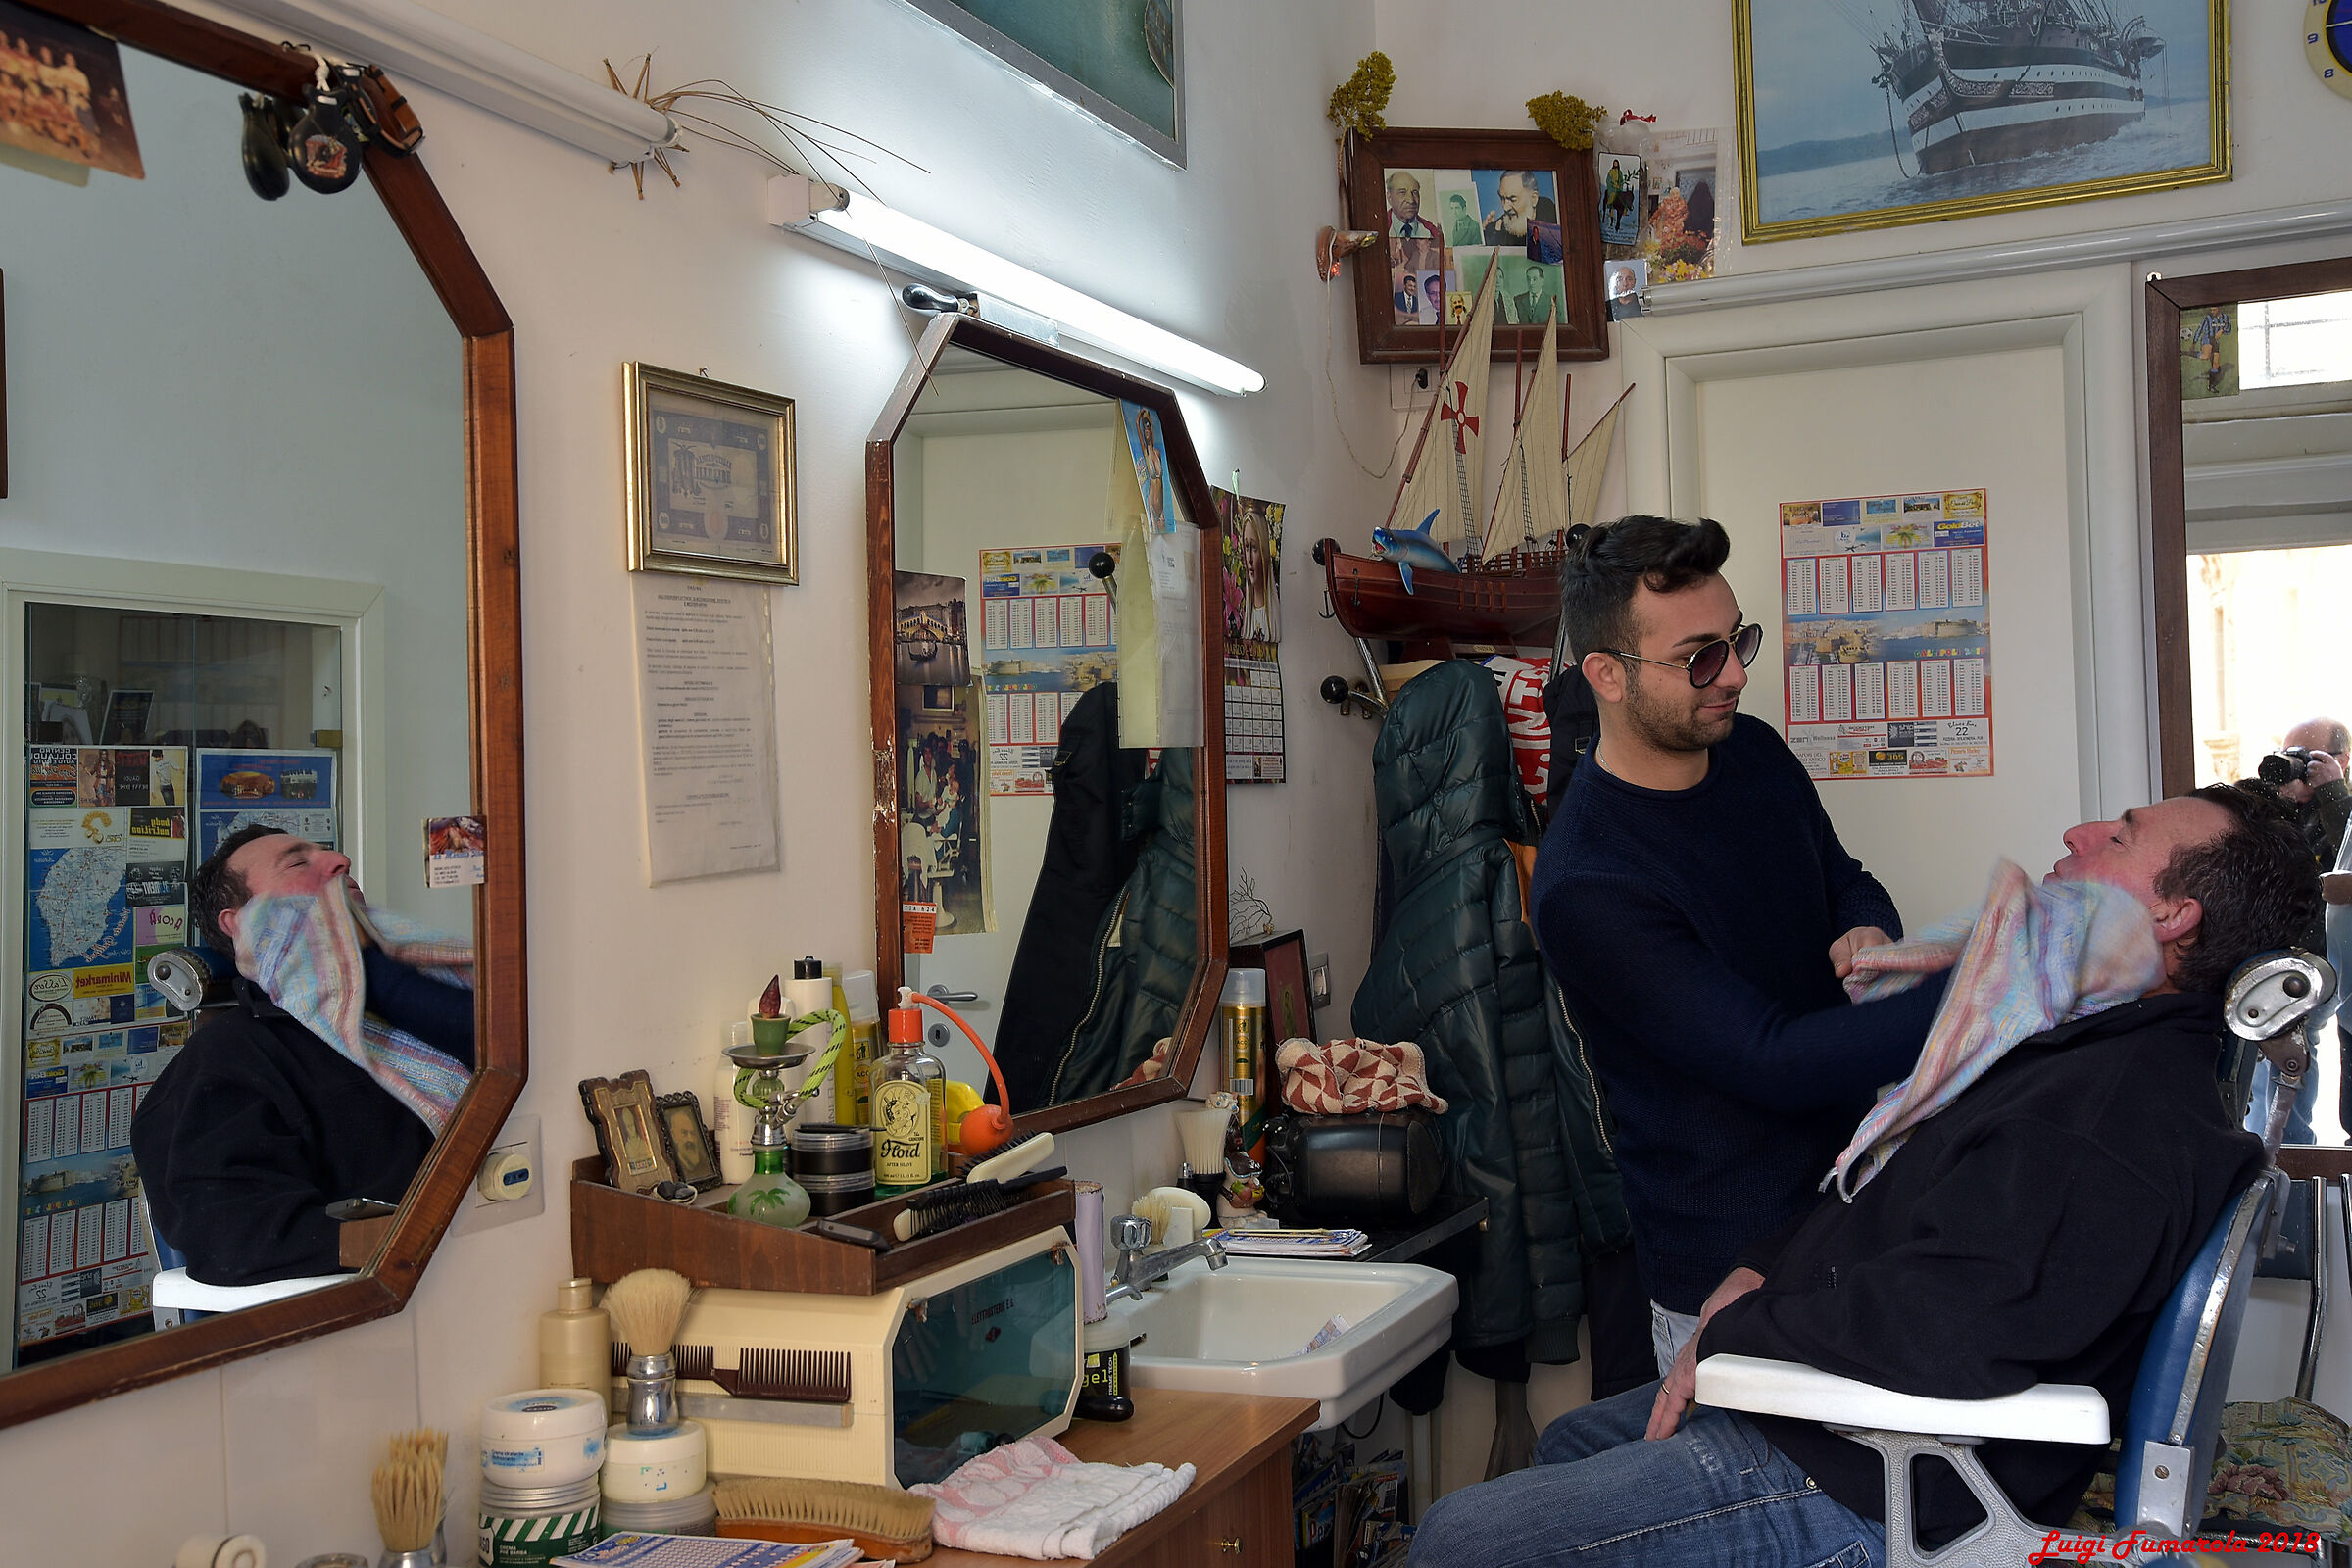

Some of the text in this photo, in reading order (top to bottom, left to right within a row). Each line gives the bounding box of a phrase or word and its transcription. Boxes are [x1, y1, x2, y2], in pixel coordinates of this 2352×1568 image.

[2308, 33, 2318, 44] 9
[2324, 68, 2333, 79] 8
[1914, 648, 1960, 657] GALLIPOLI
[1955, 727, 1968, 736] 22
[1082, 1368, 1109, 1388] gel
